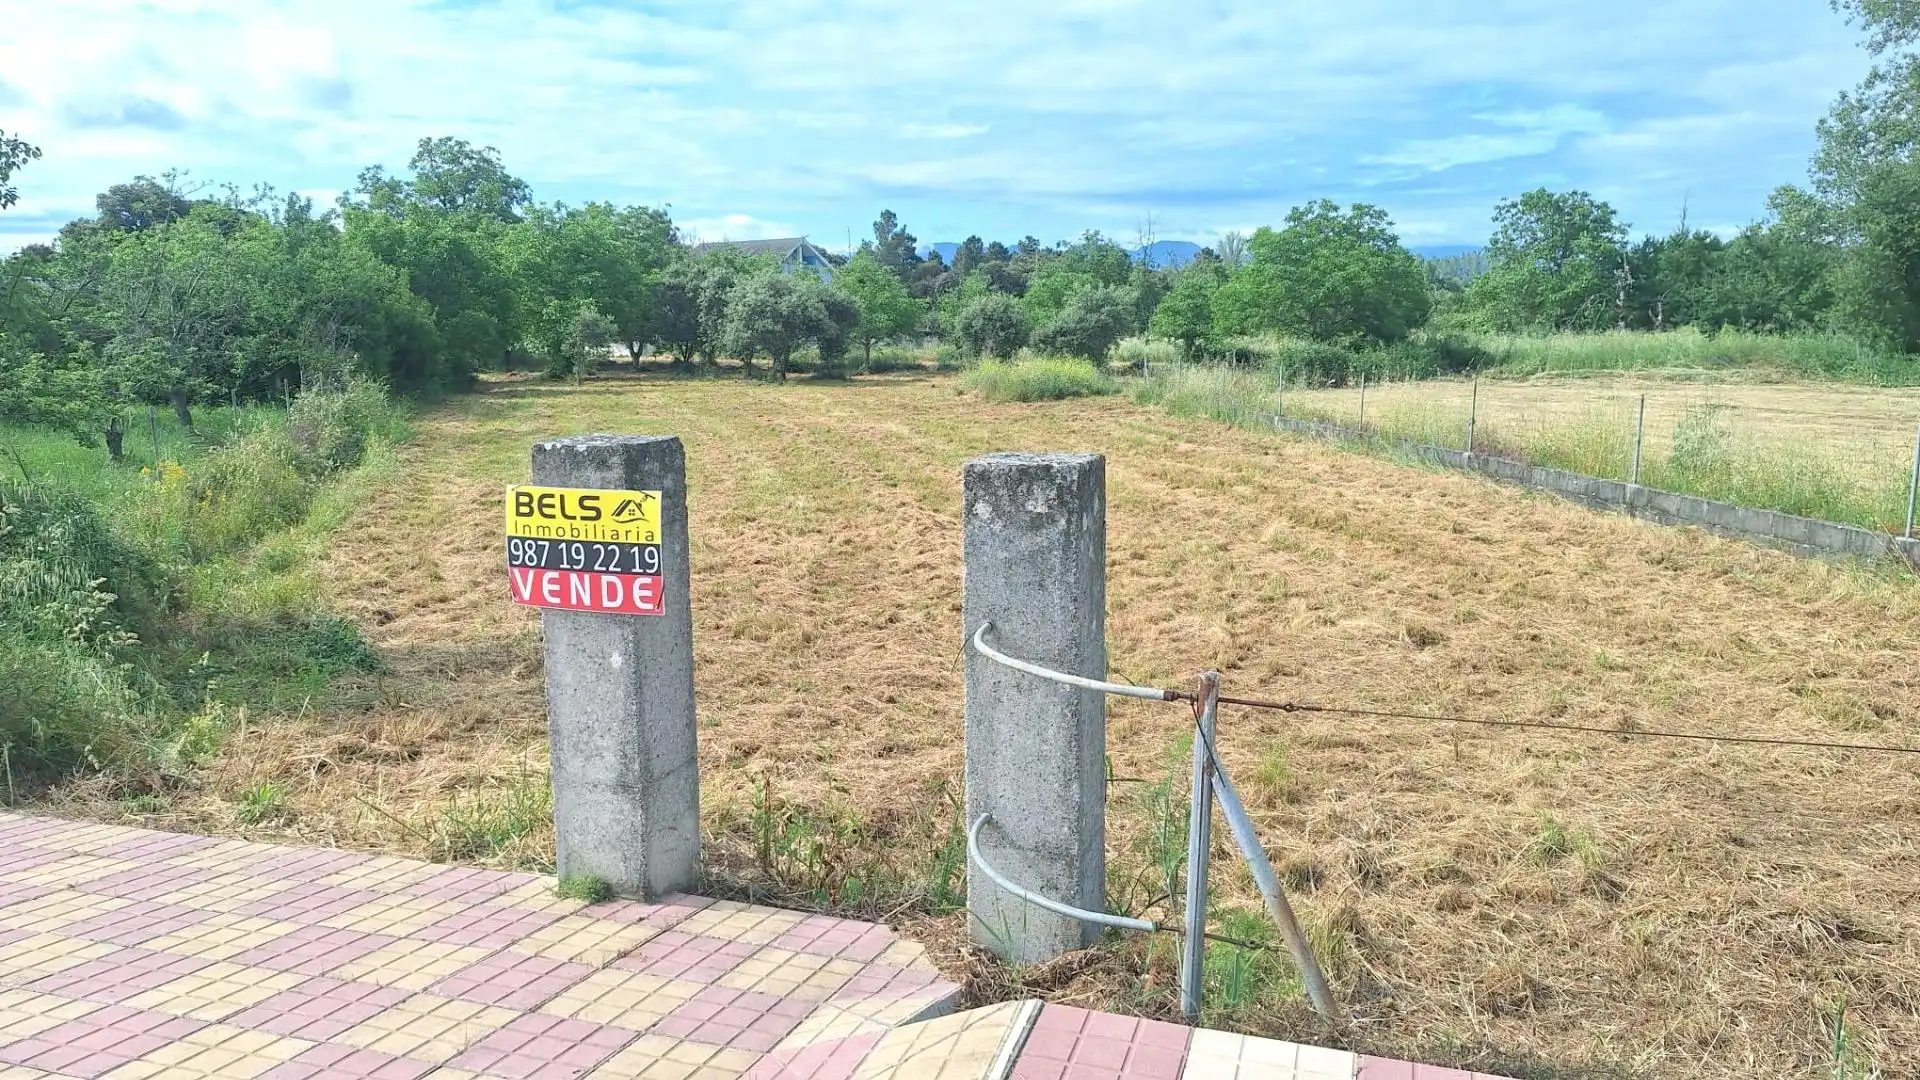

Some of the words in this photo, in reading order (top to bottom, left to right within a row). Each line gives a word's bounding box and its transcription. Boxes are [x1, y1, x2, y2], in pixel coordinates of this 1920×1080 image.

[515, 491, 602, 521] BELS
[514, 520, 655, 542] Inmobiliaria
[510, 539, 549, 567] 987
[558, 542, 585, 570] 19
[592, 544, 621, 572] 22
[630, 546, 659, 573] 19
[512, 568, 654, 610] VENDE
